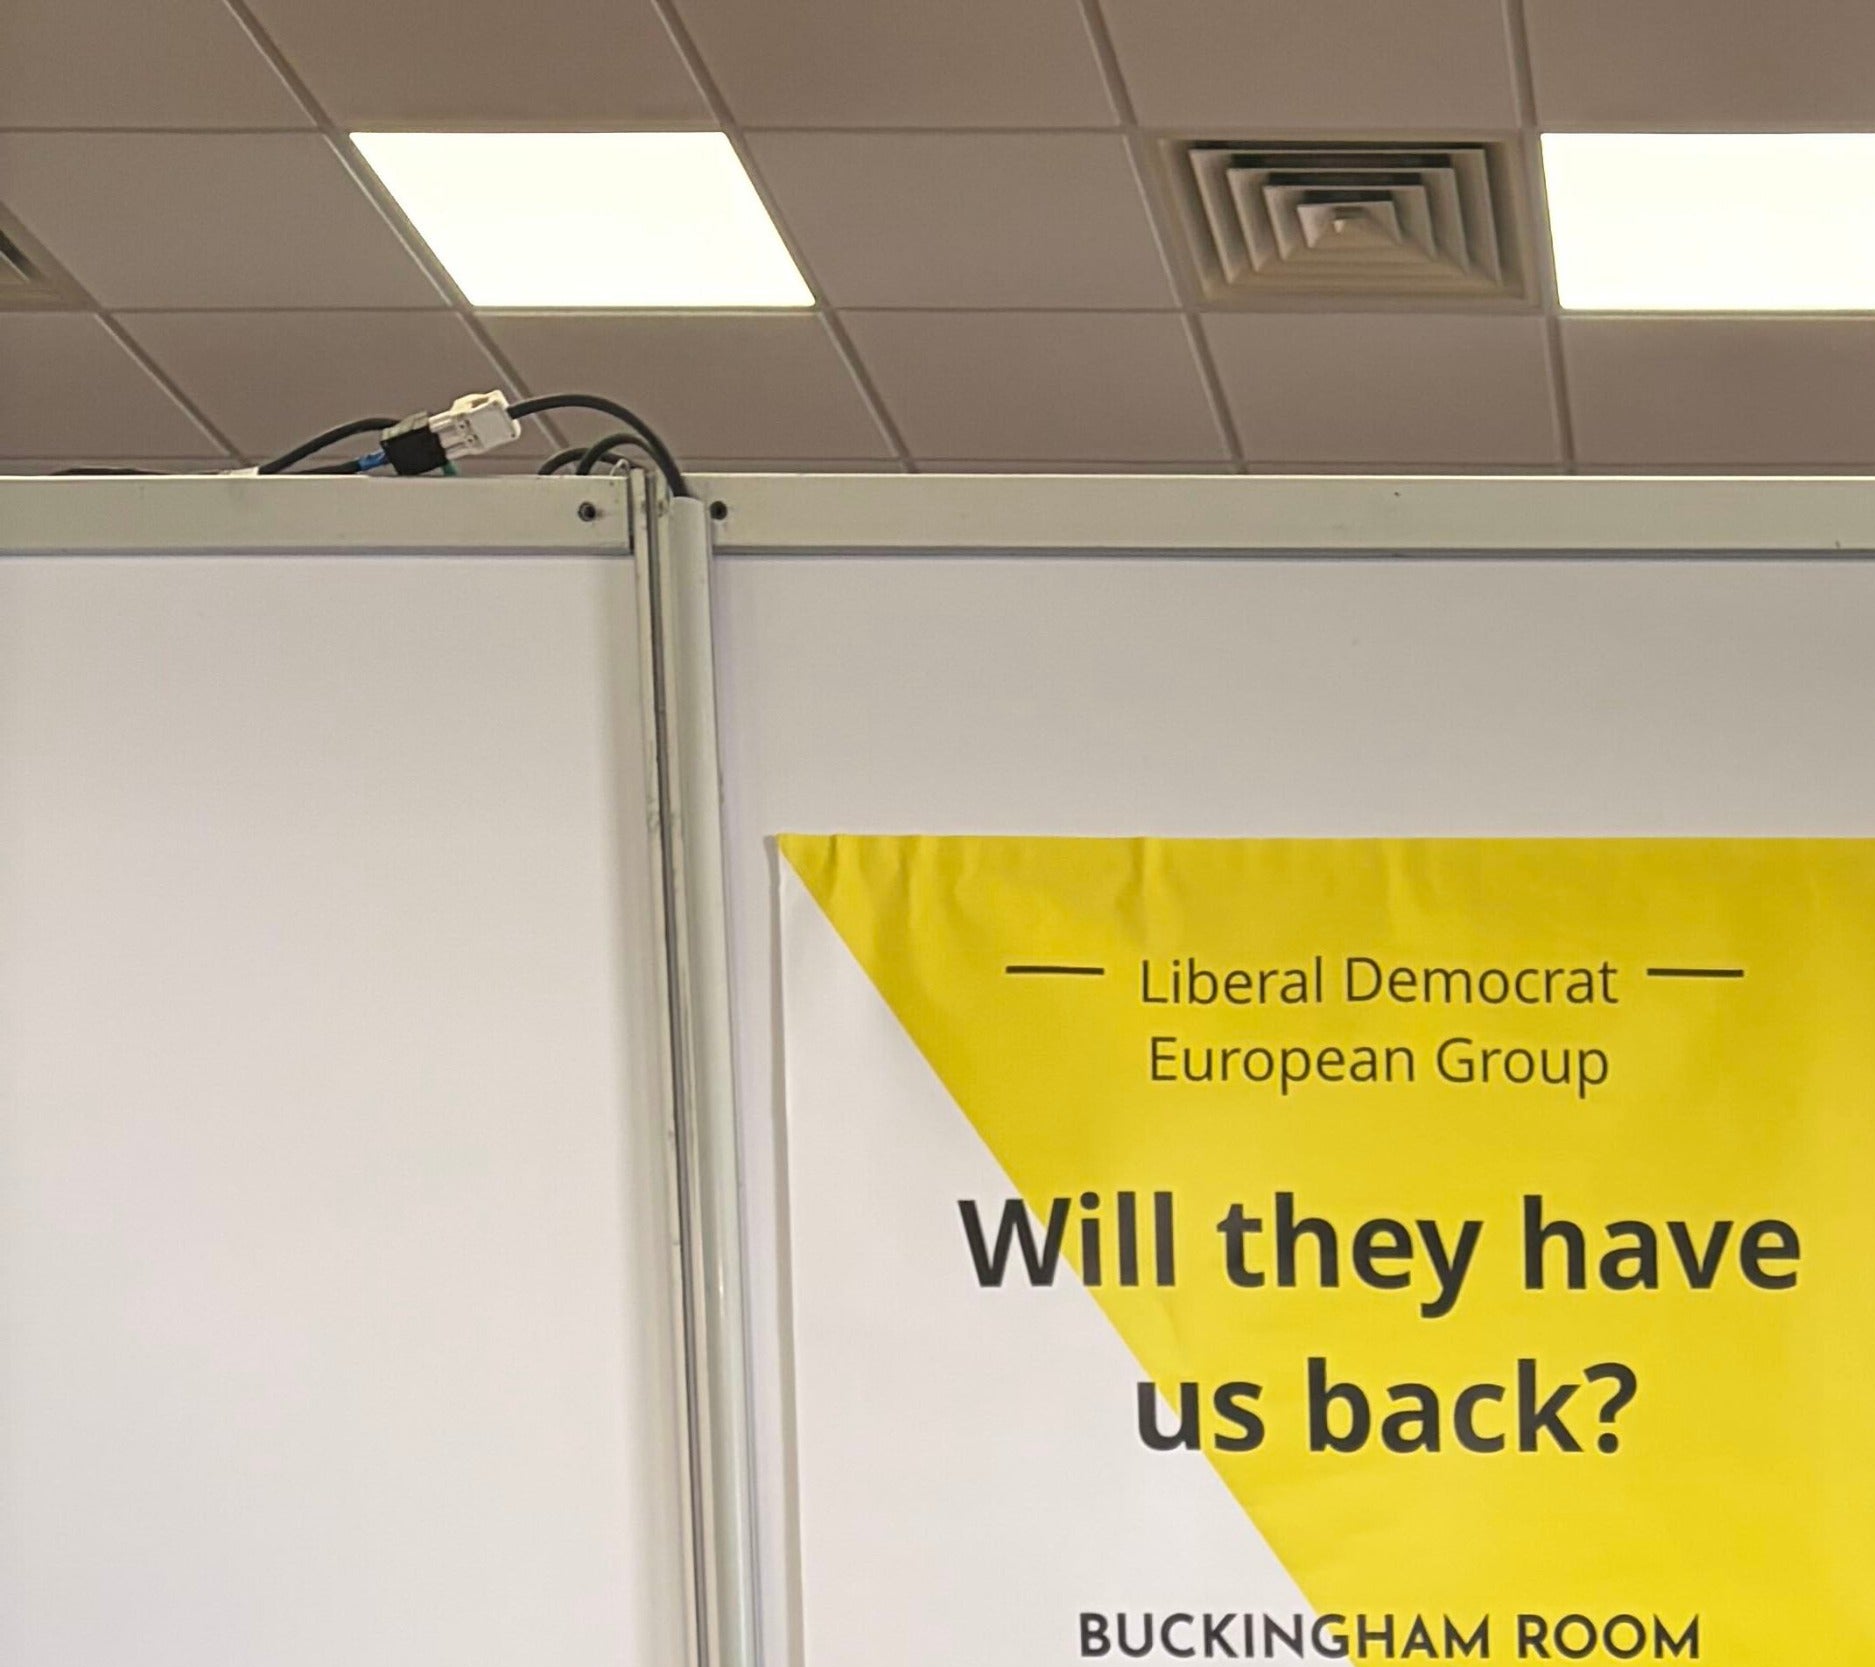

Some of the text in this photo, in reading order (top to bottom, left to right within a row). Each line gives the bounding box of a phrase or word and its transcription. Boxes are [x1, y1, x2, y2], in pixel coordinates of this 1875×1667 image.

[1143, 956, 1618, 1004] Liberal Democrat
[1151, 1037, 1608, 1099] European Group
[958, 1191, 1800, 1318] Will they have
[1137, 1357, 1637, 1453] us back?
[1080, 1613, 1699, 1659] BUCKINGHAM ROOM
